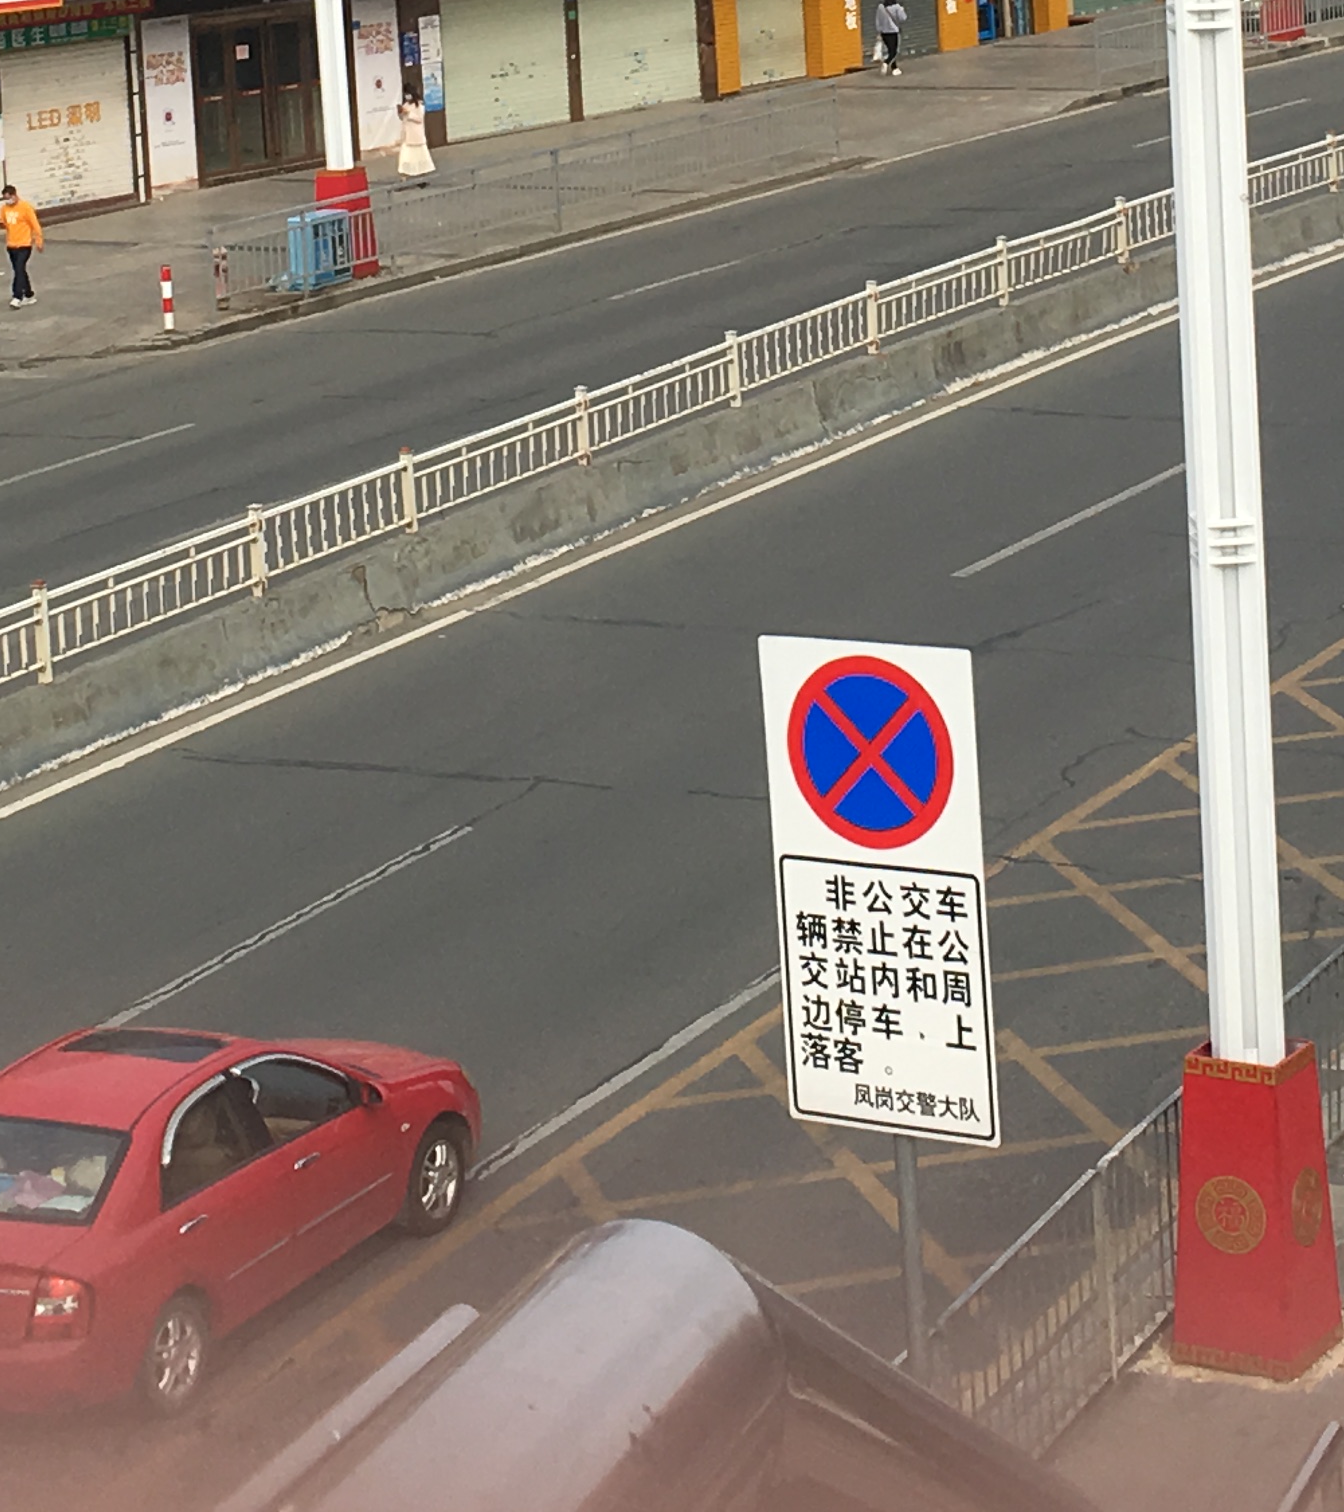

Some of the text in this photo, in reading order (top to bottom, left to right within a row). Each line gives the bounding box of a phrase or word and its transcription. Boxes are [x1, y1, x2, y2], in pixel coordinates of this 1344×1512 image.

[26, 109, 62, 131] LED
[826, 874, 968, 923] 非公交车
[796, 911, 970, 965] 辆禁止在公
[799, 955, 972, 1009] 交站内和周
[802, 995, 977, 1053] 边停车、上
[853, 1083, 981, 1124] 凤岗交警大队
